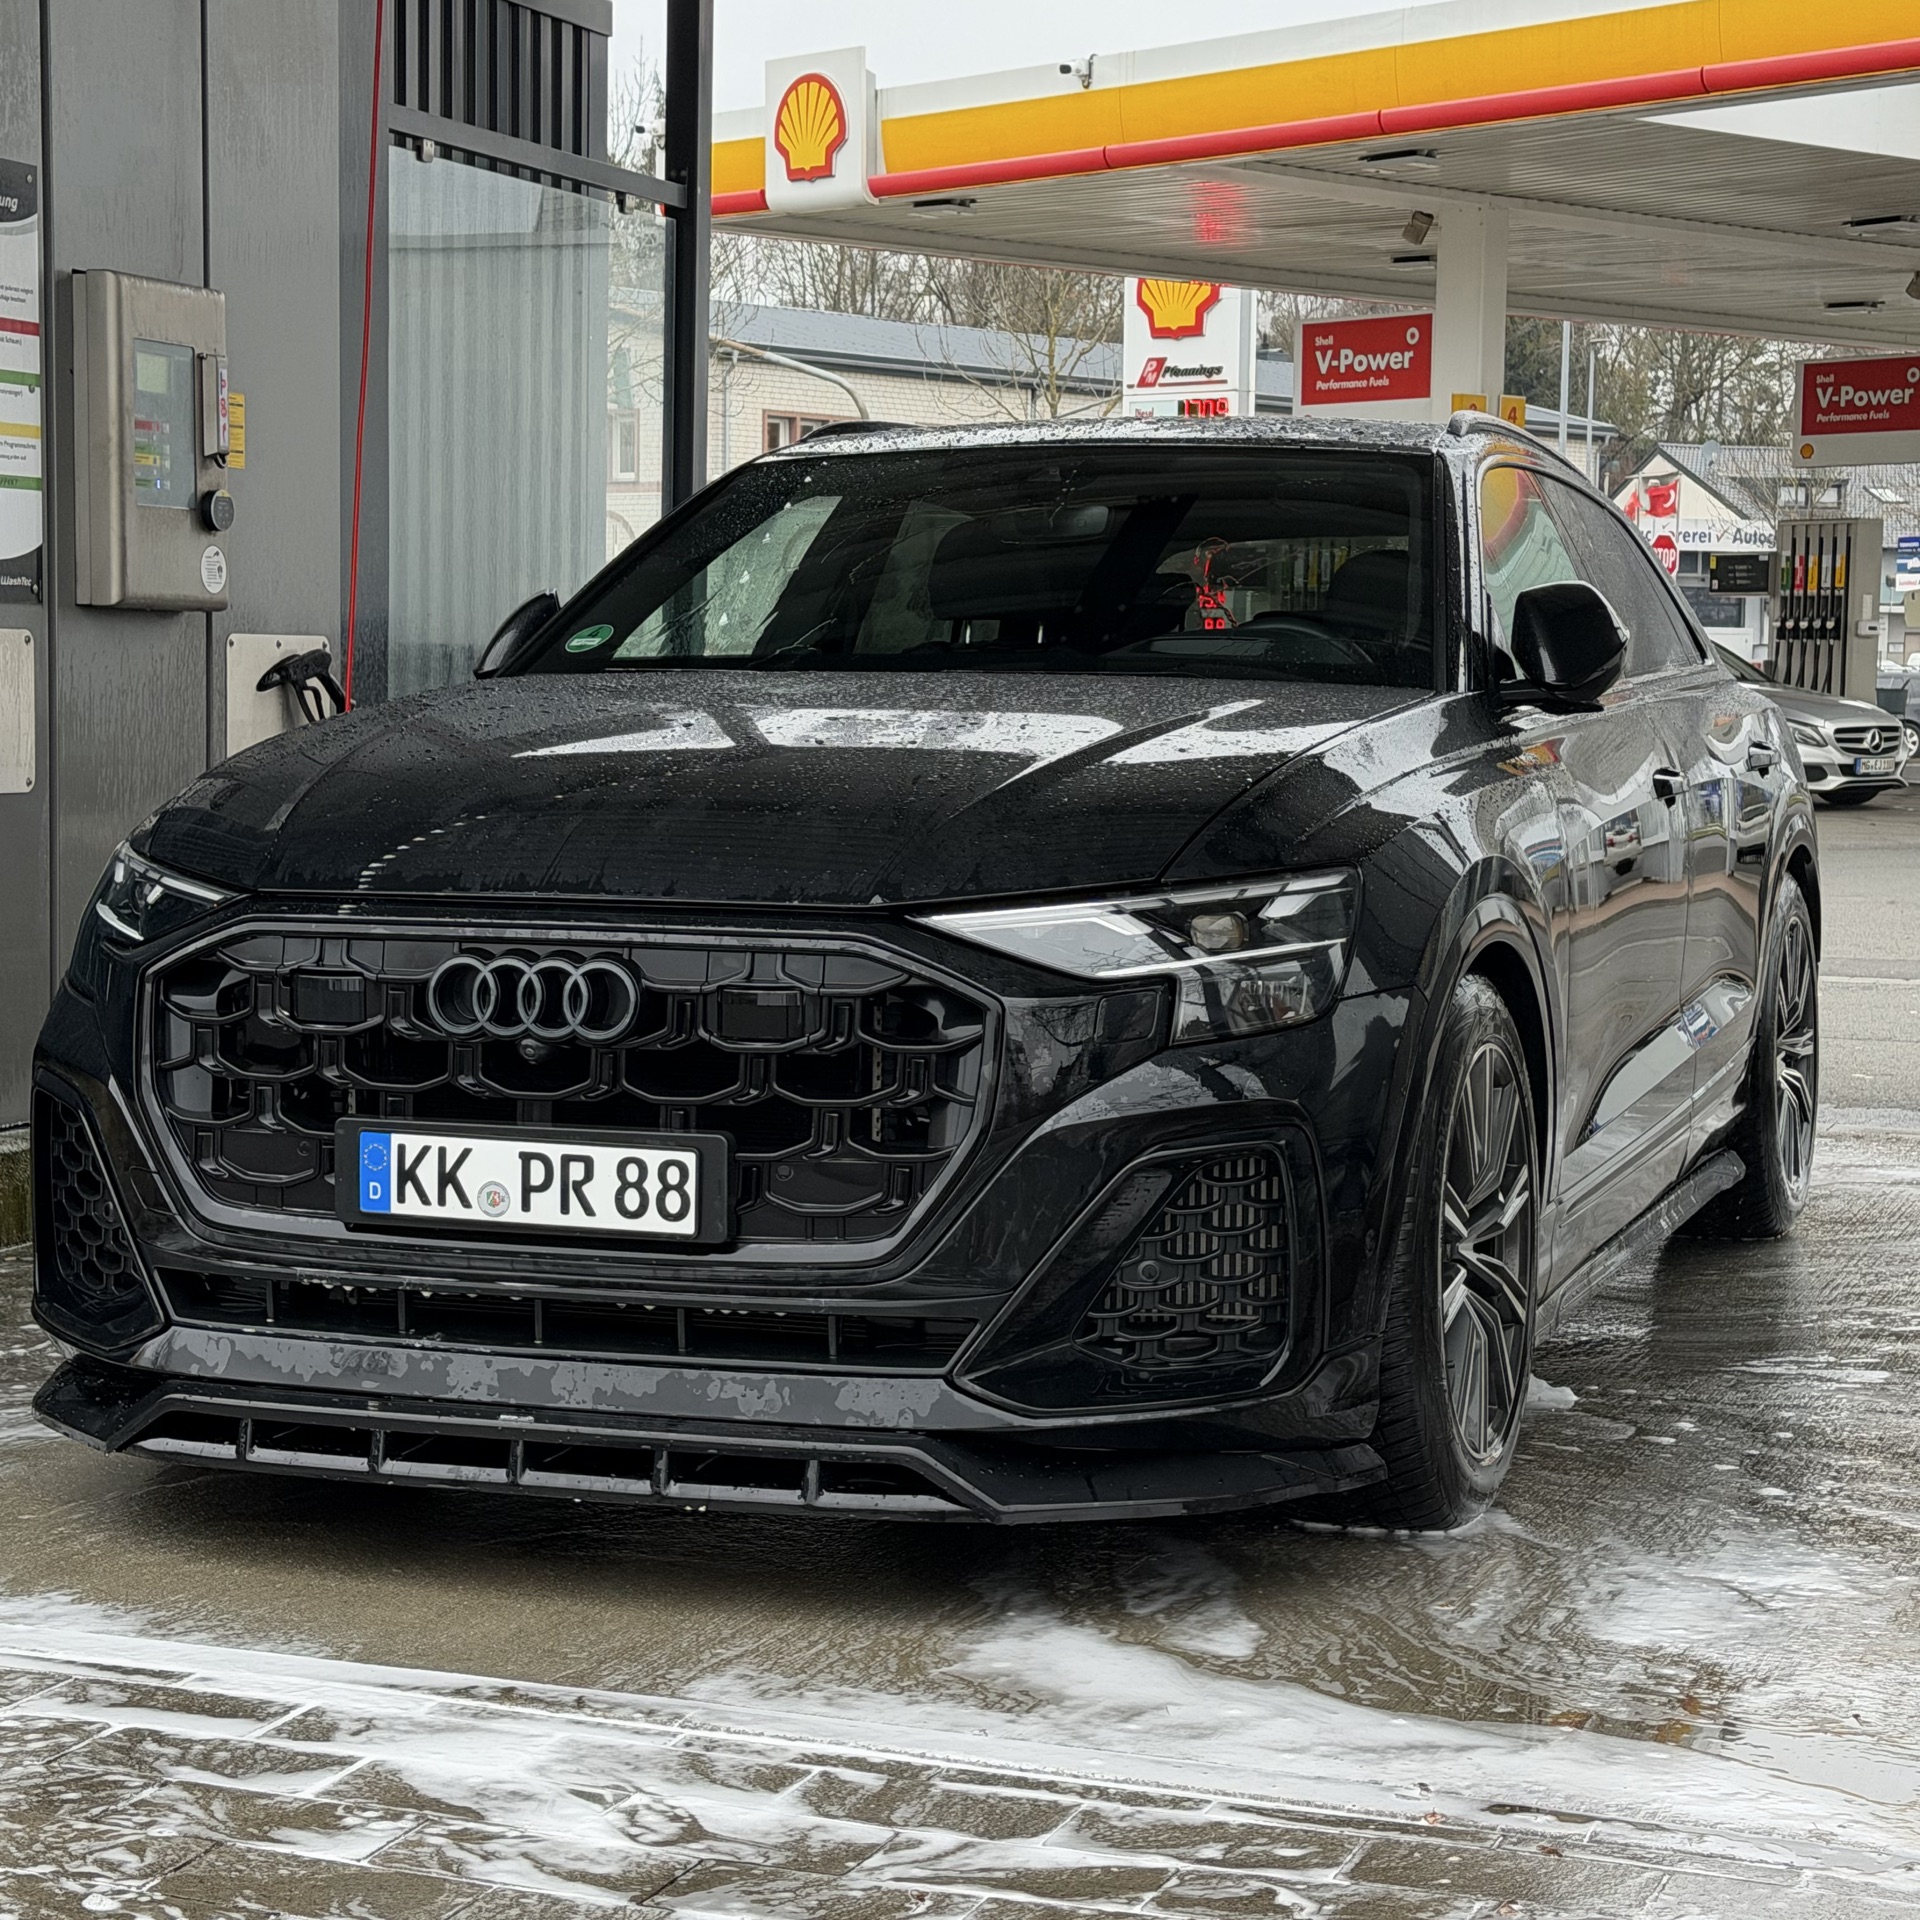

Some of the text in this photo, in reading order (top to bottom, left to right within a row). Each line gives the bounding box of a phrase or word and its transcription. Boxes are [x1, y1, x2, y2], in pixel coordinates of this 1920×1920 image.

[1315, 335, 1333, 346] Shell
[1315, 348, 1414, 375] V-Power
[1316, 375, 1390, 391] Performance Fuels
[1816, 373, 1835, 384] Shell
[1816, 385, 1914, 409] V-Power
[1816, 409, 1890, 423] Performance Fuels
[369, 1142, 692, 1223] D KK PR 88
